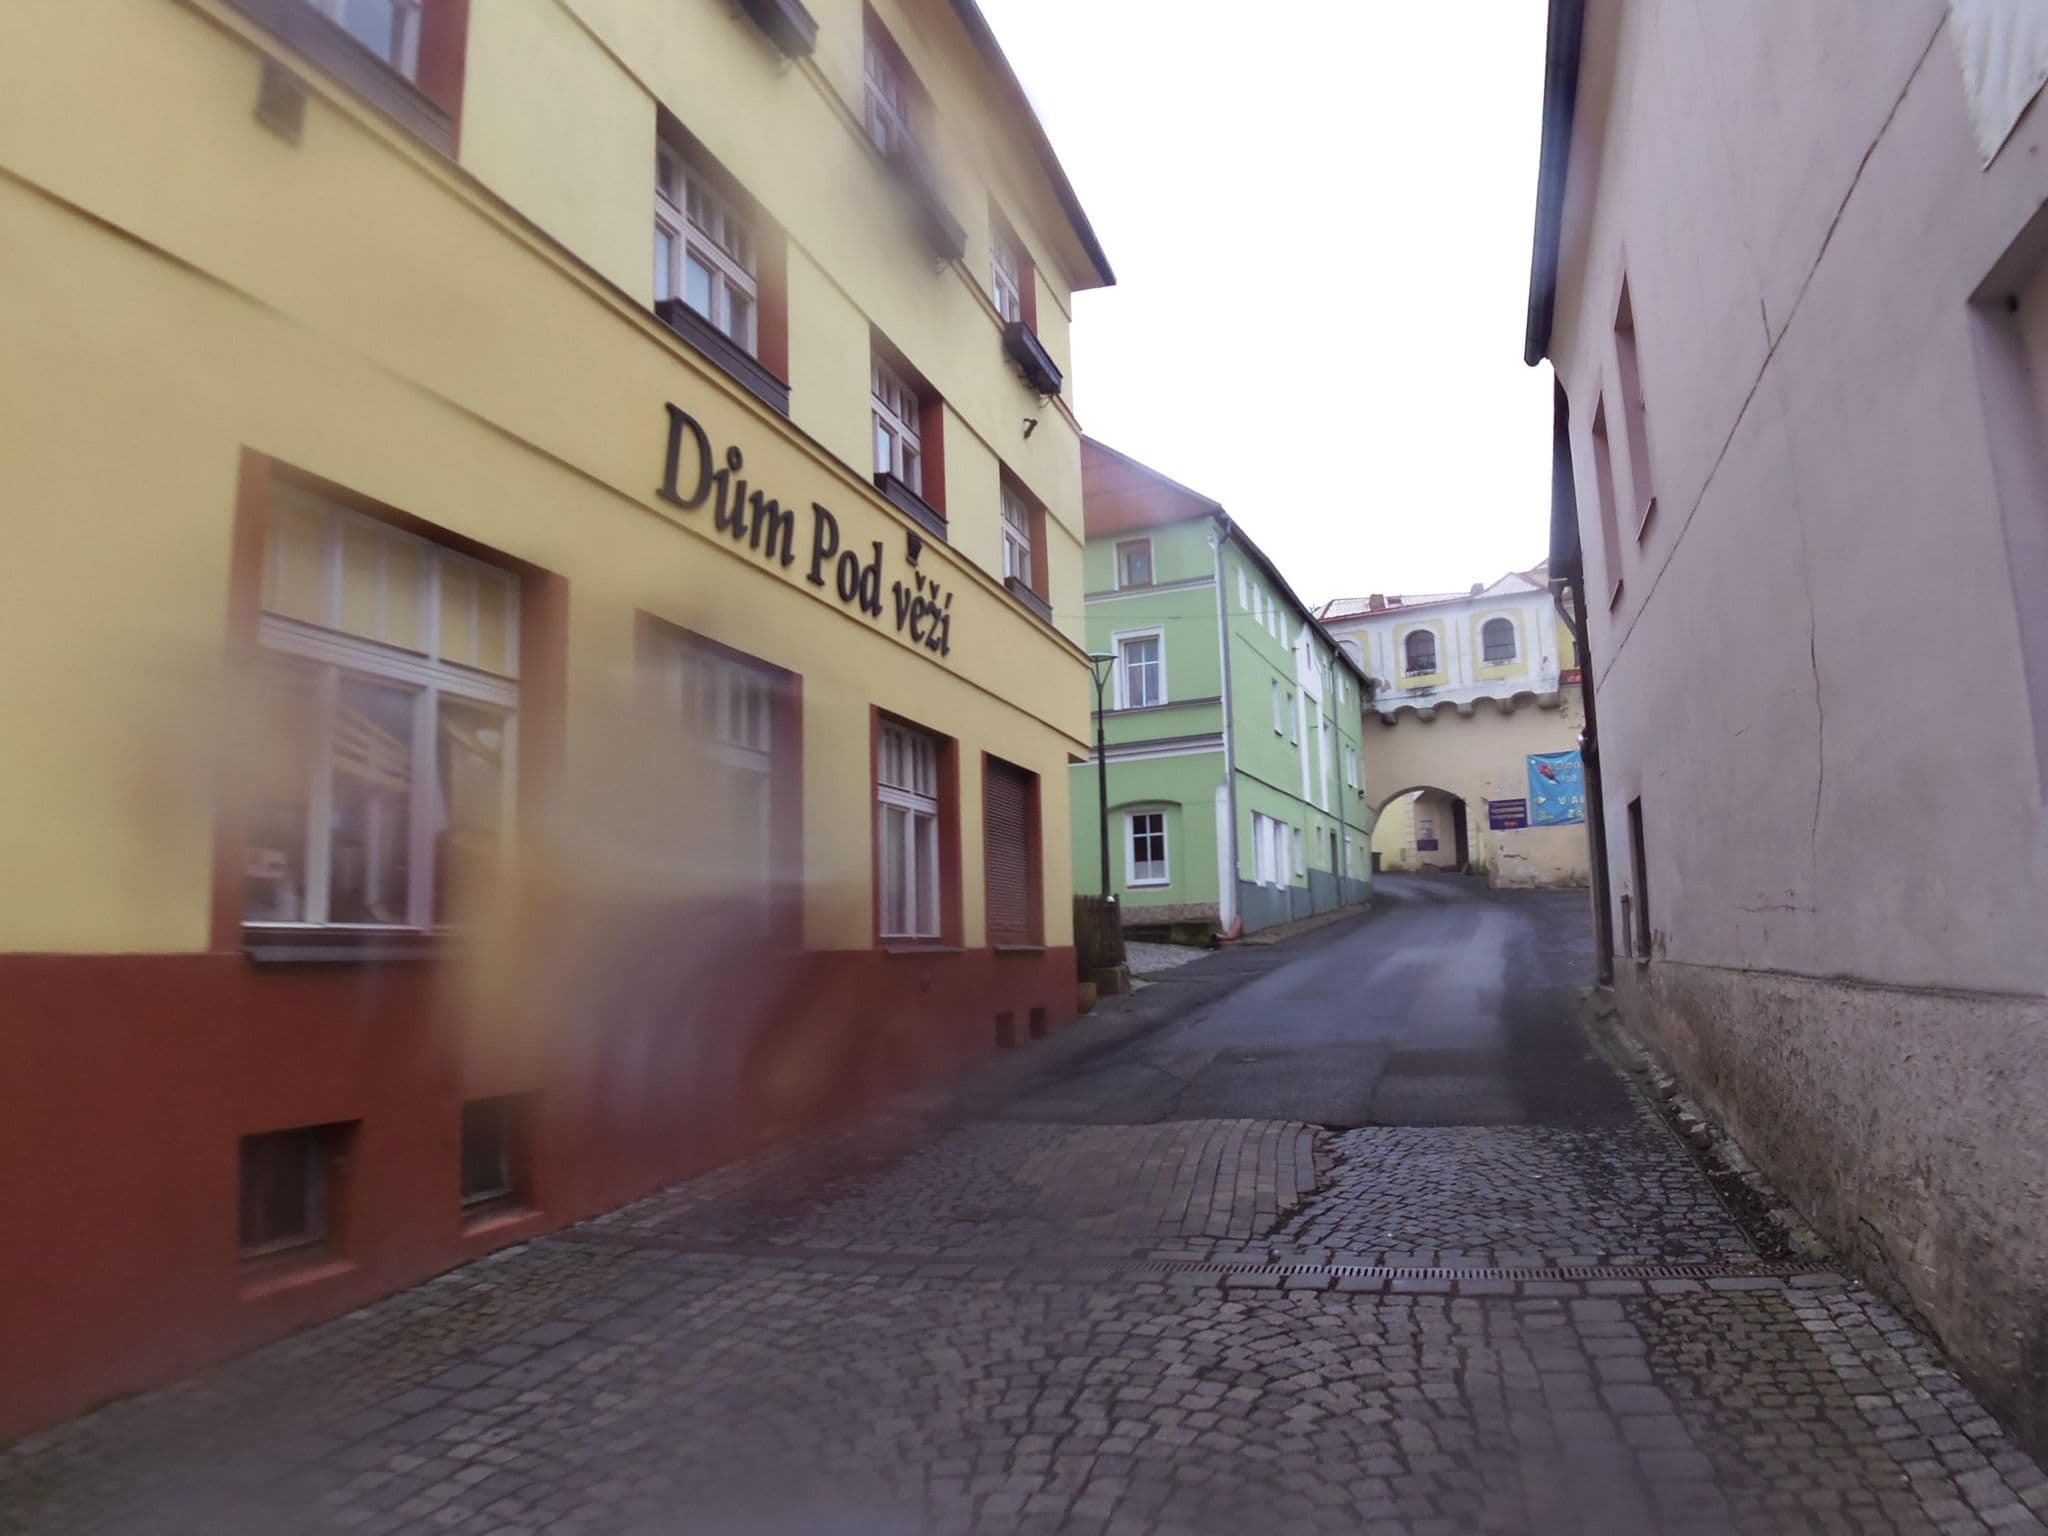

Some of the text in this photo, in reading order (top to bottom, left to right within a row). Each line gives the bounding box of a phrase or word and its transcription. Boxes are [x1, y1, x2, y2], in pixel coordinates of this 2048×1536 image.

[655, 401, 954, 657] Dům Pod věží
